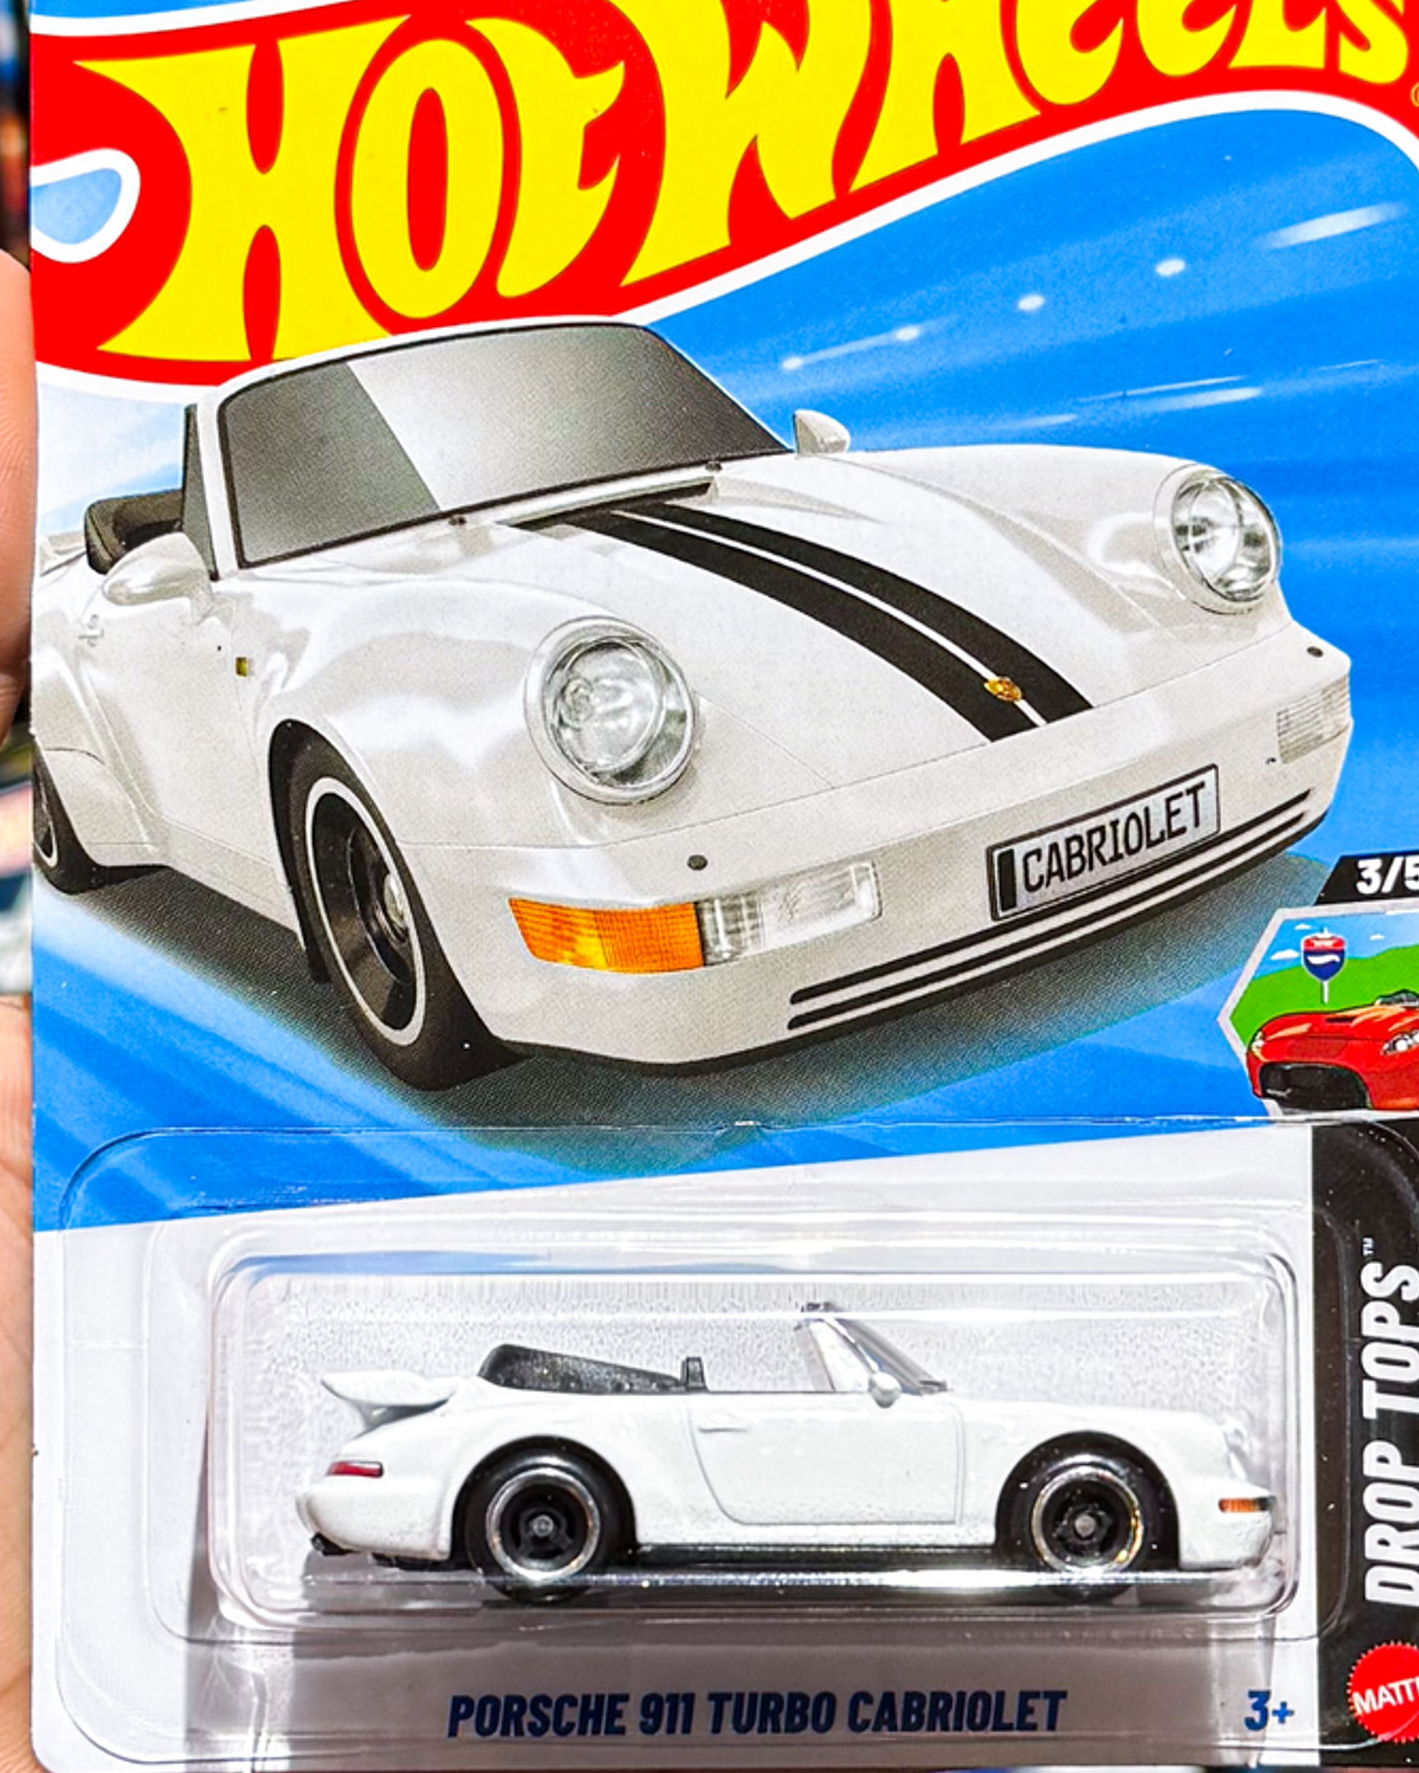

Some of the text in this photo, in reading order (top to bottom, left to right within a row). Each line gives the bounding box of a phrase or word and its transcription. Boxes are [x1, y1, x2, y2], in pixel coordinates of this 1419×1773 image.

[1022, 780, 1207, 894] CABRIOLET
[446, 1689, 1069, 1739] PORSCHE 911 TURBO CABRIOLET
[1243, 1688, 1296, 1732] 3+
